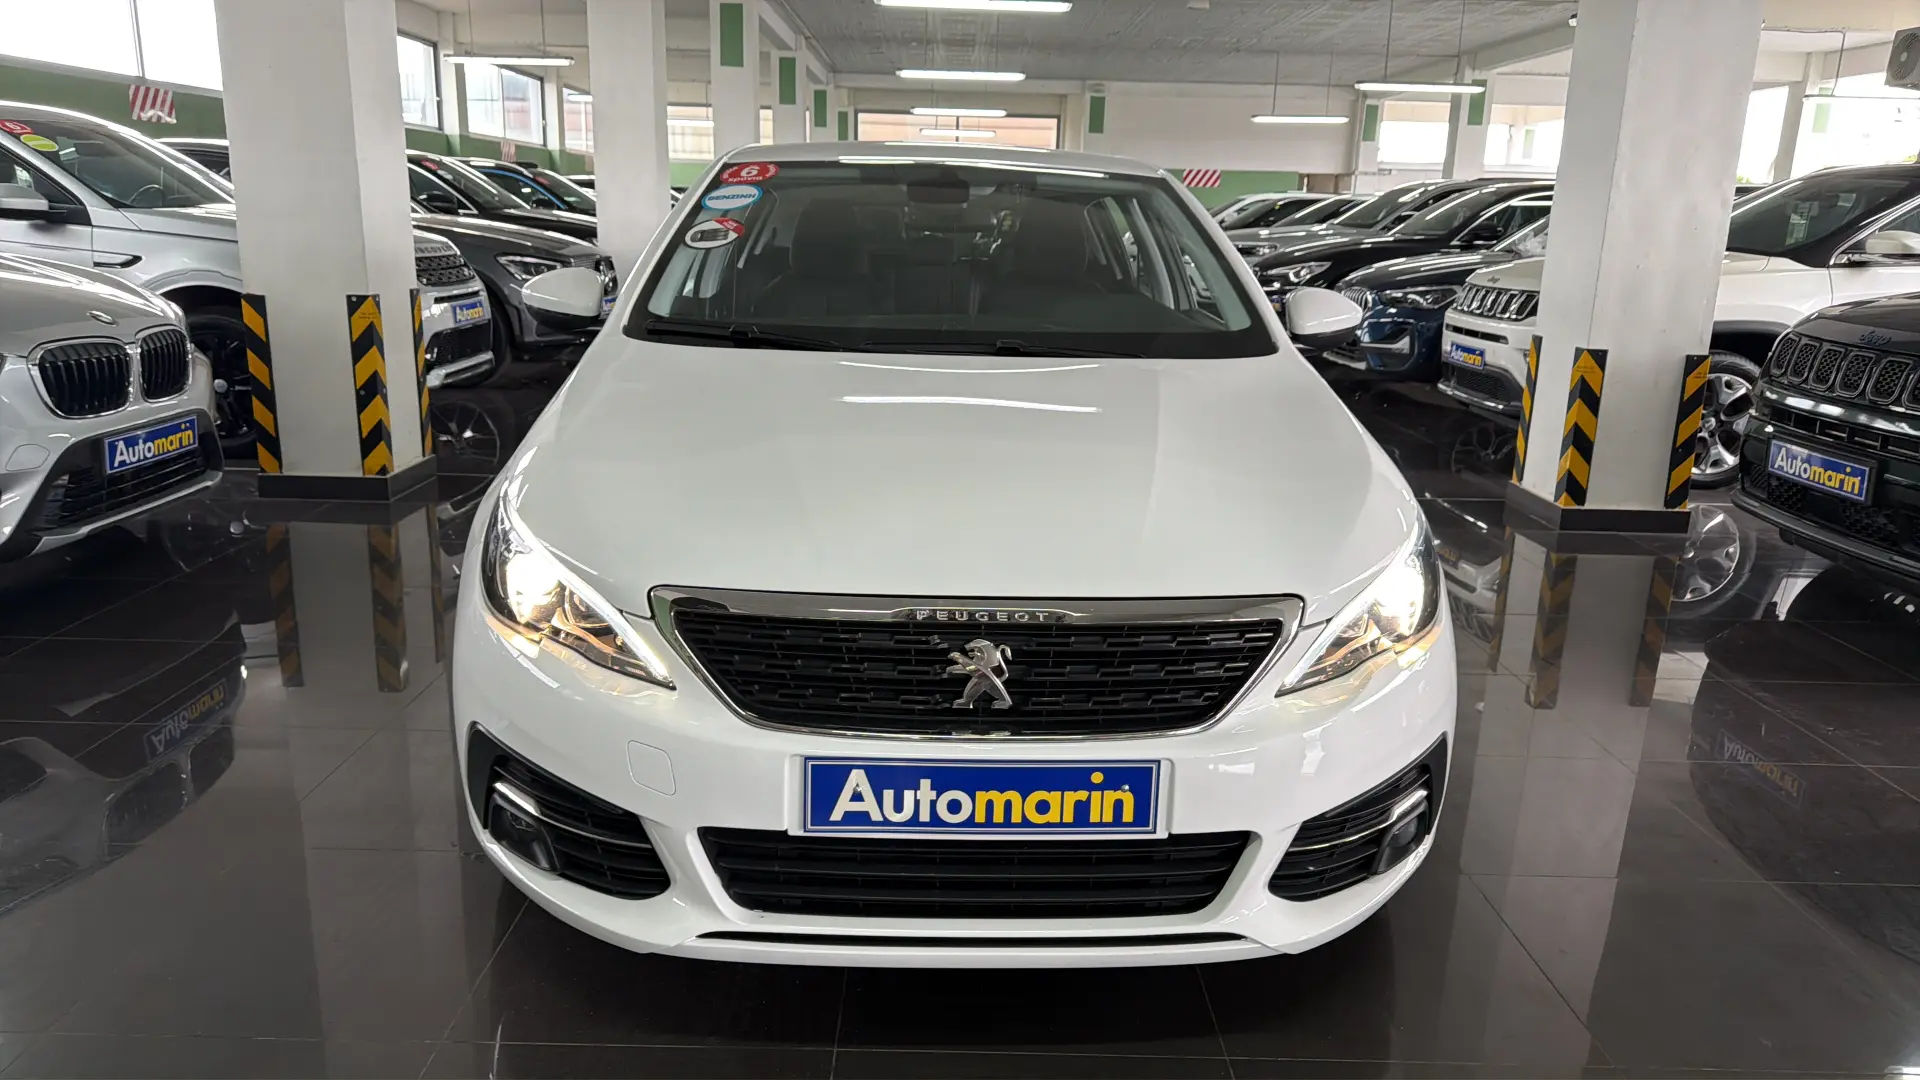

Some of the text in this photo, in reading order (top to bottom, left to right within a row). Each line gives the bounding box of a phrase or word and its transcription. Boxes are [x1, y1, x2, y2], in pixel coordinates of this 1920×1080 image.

[740, 165, 760, 178] 6
[113, 422, 194, 468] Automarin
[1774, 447, 1861, 495] Automarin
[916, 610, 1049, 622] PEUGEOT
[829, 769, 1135, 823] Automarin
